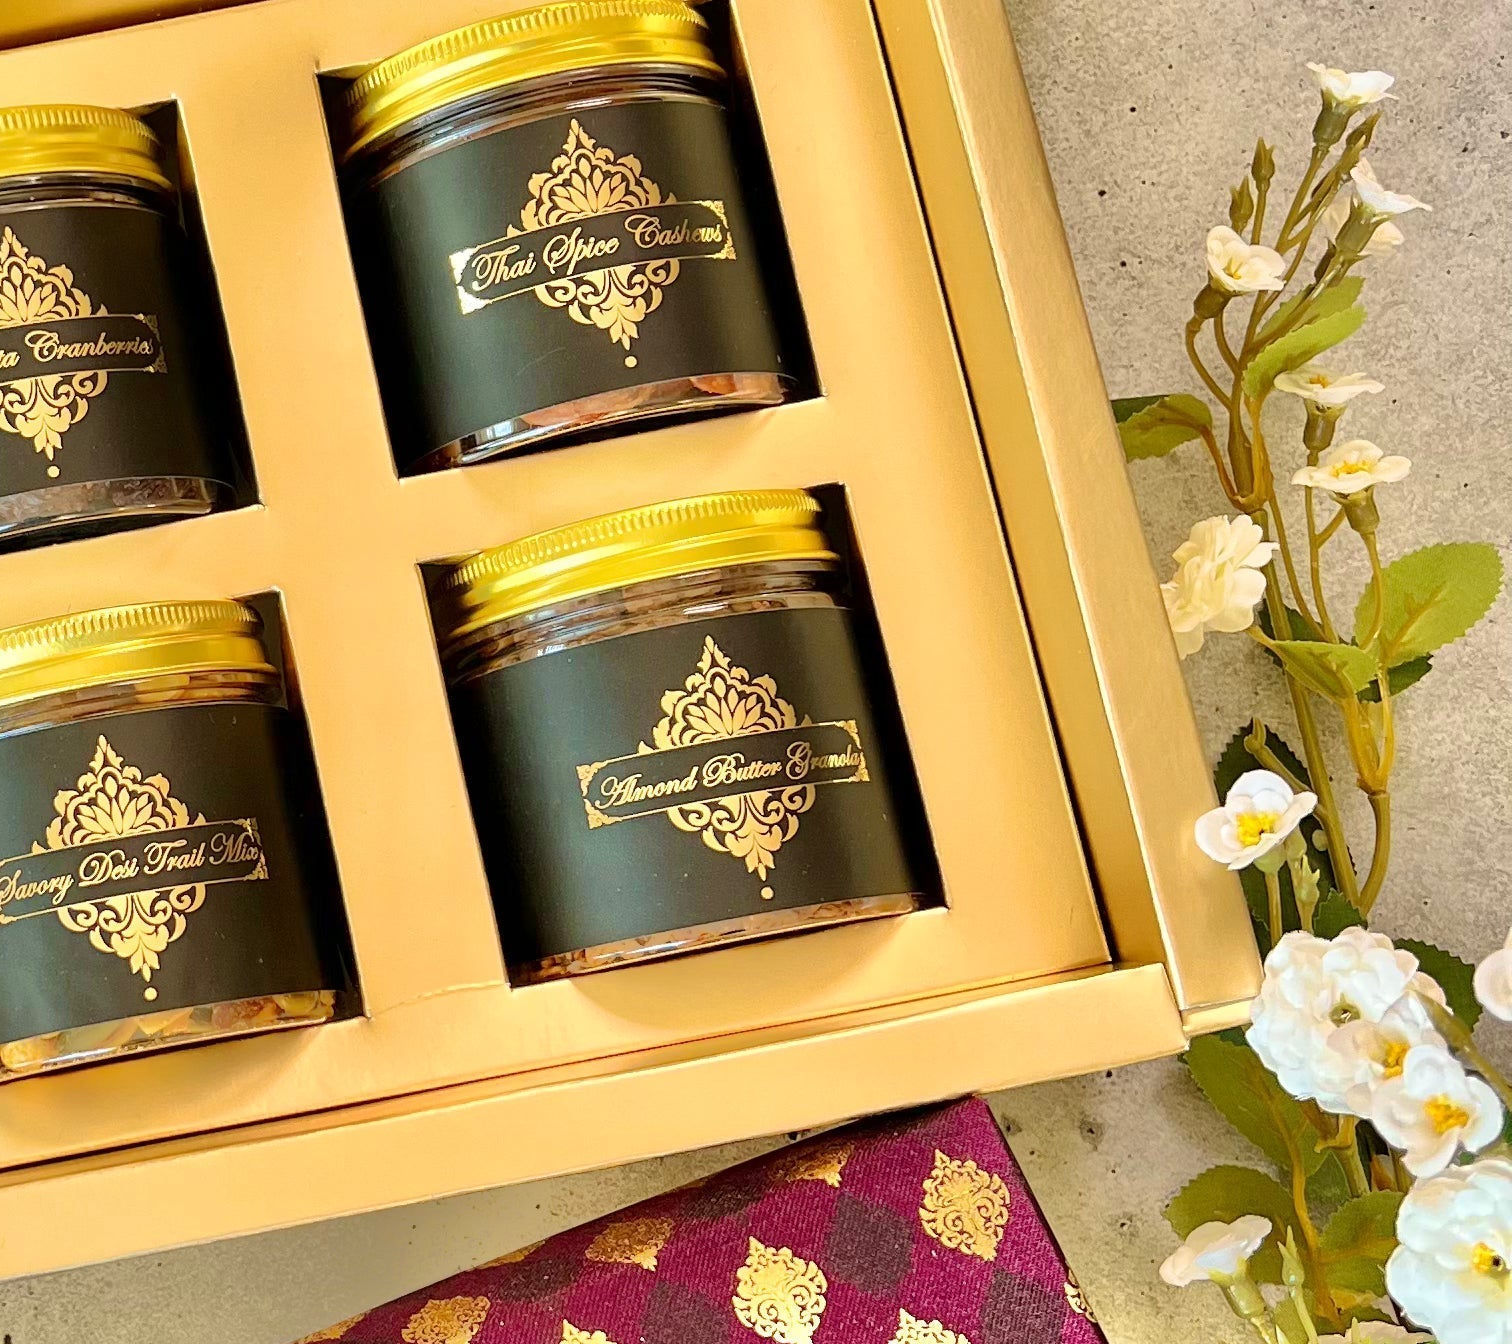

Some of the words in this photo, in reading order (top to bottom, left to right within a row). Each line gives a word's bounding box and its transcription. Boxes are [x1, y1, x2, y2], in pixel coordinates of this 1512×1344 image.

[472, 245, 537, 291] Thai
[542, 226, 620, 275] Spice
[624, 214, 723, 249] Cashews
[24, 329, 154, 363] Cranberries
[594, 768, 699, 809] Almond
[701, 753, 782, 788] Butter
[78, 850, 140, 888] Desi
[143, 839, 205, 876] Trail
[208, 831, 261, 866] Mix
